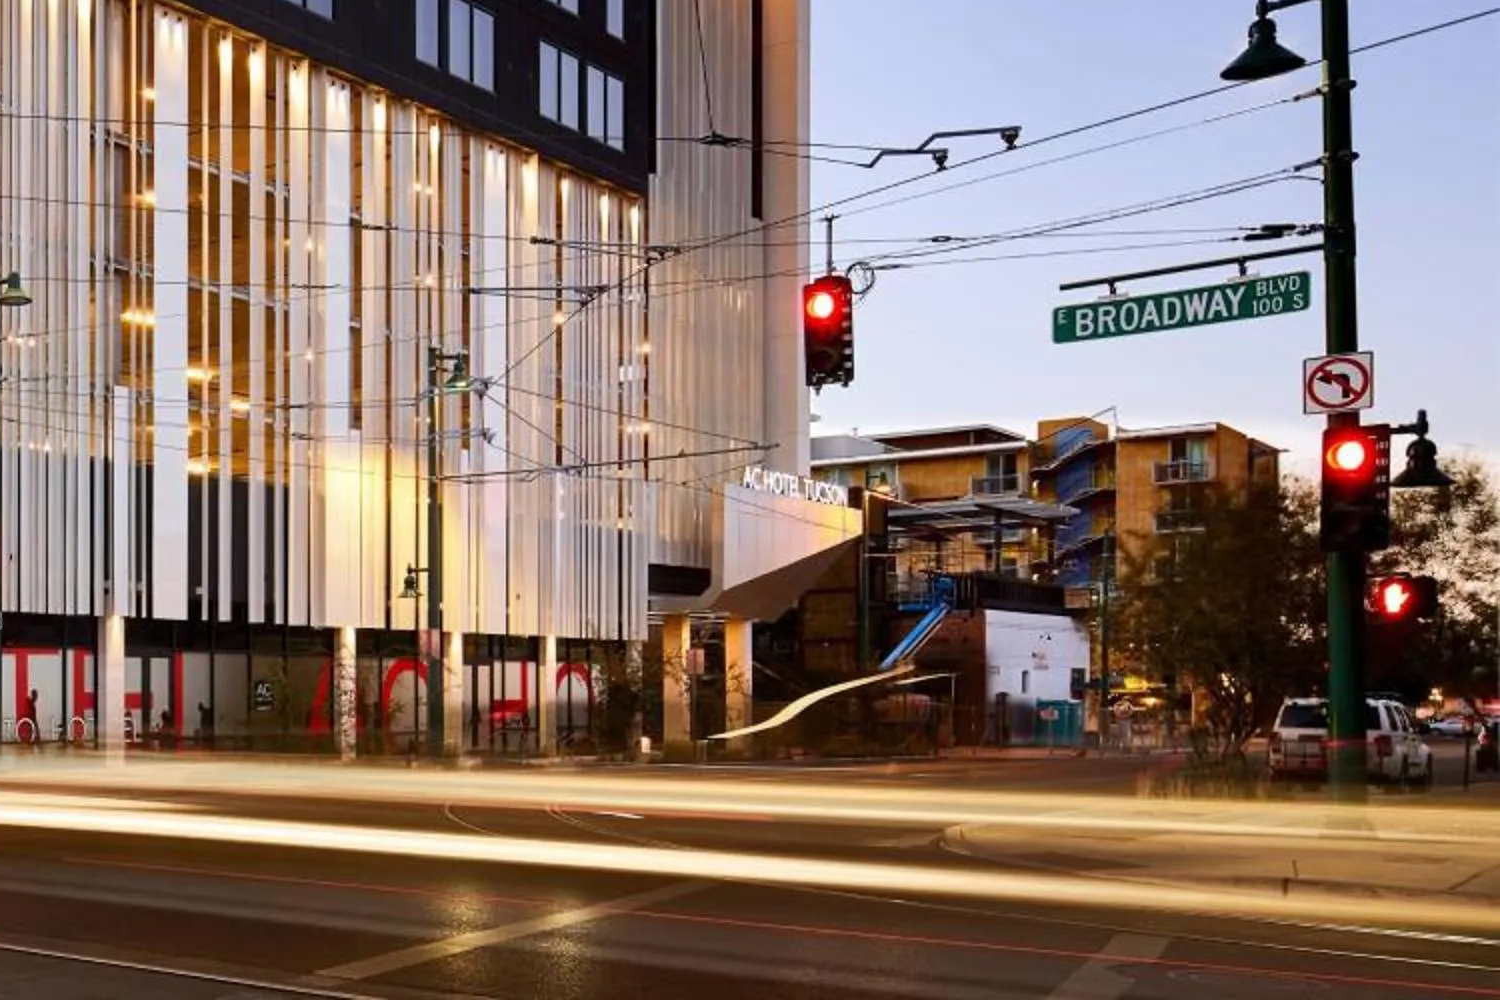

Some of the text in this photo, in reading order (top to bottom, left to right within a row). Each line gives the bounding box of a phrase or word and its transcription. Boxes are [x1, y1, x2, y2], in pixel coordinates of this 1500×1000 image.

[1057, 274, 1301, 338] E BROADWAY BLVD
[1251, 293, 1304, 317] 100 S
[742, 465, 849, 507] AC HOTEL TUCSON
